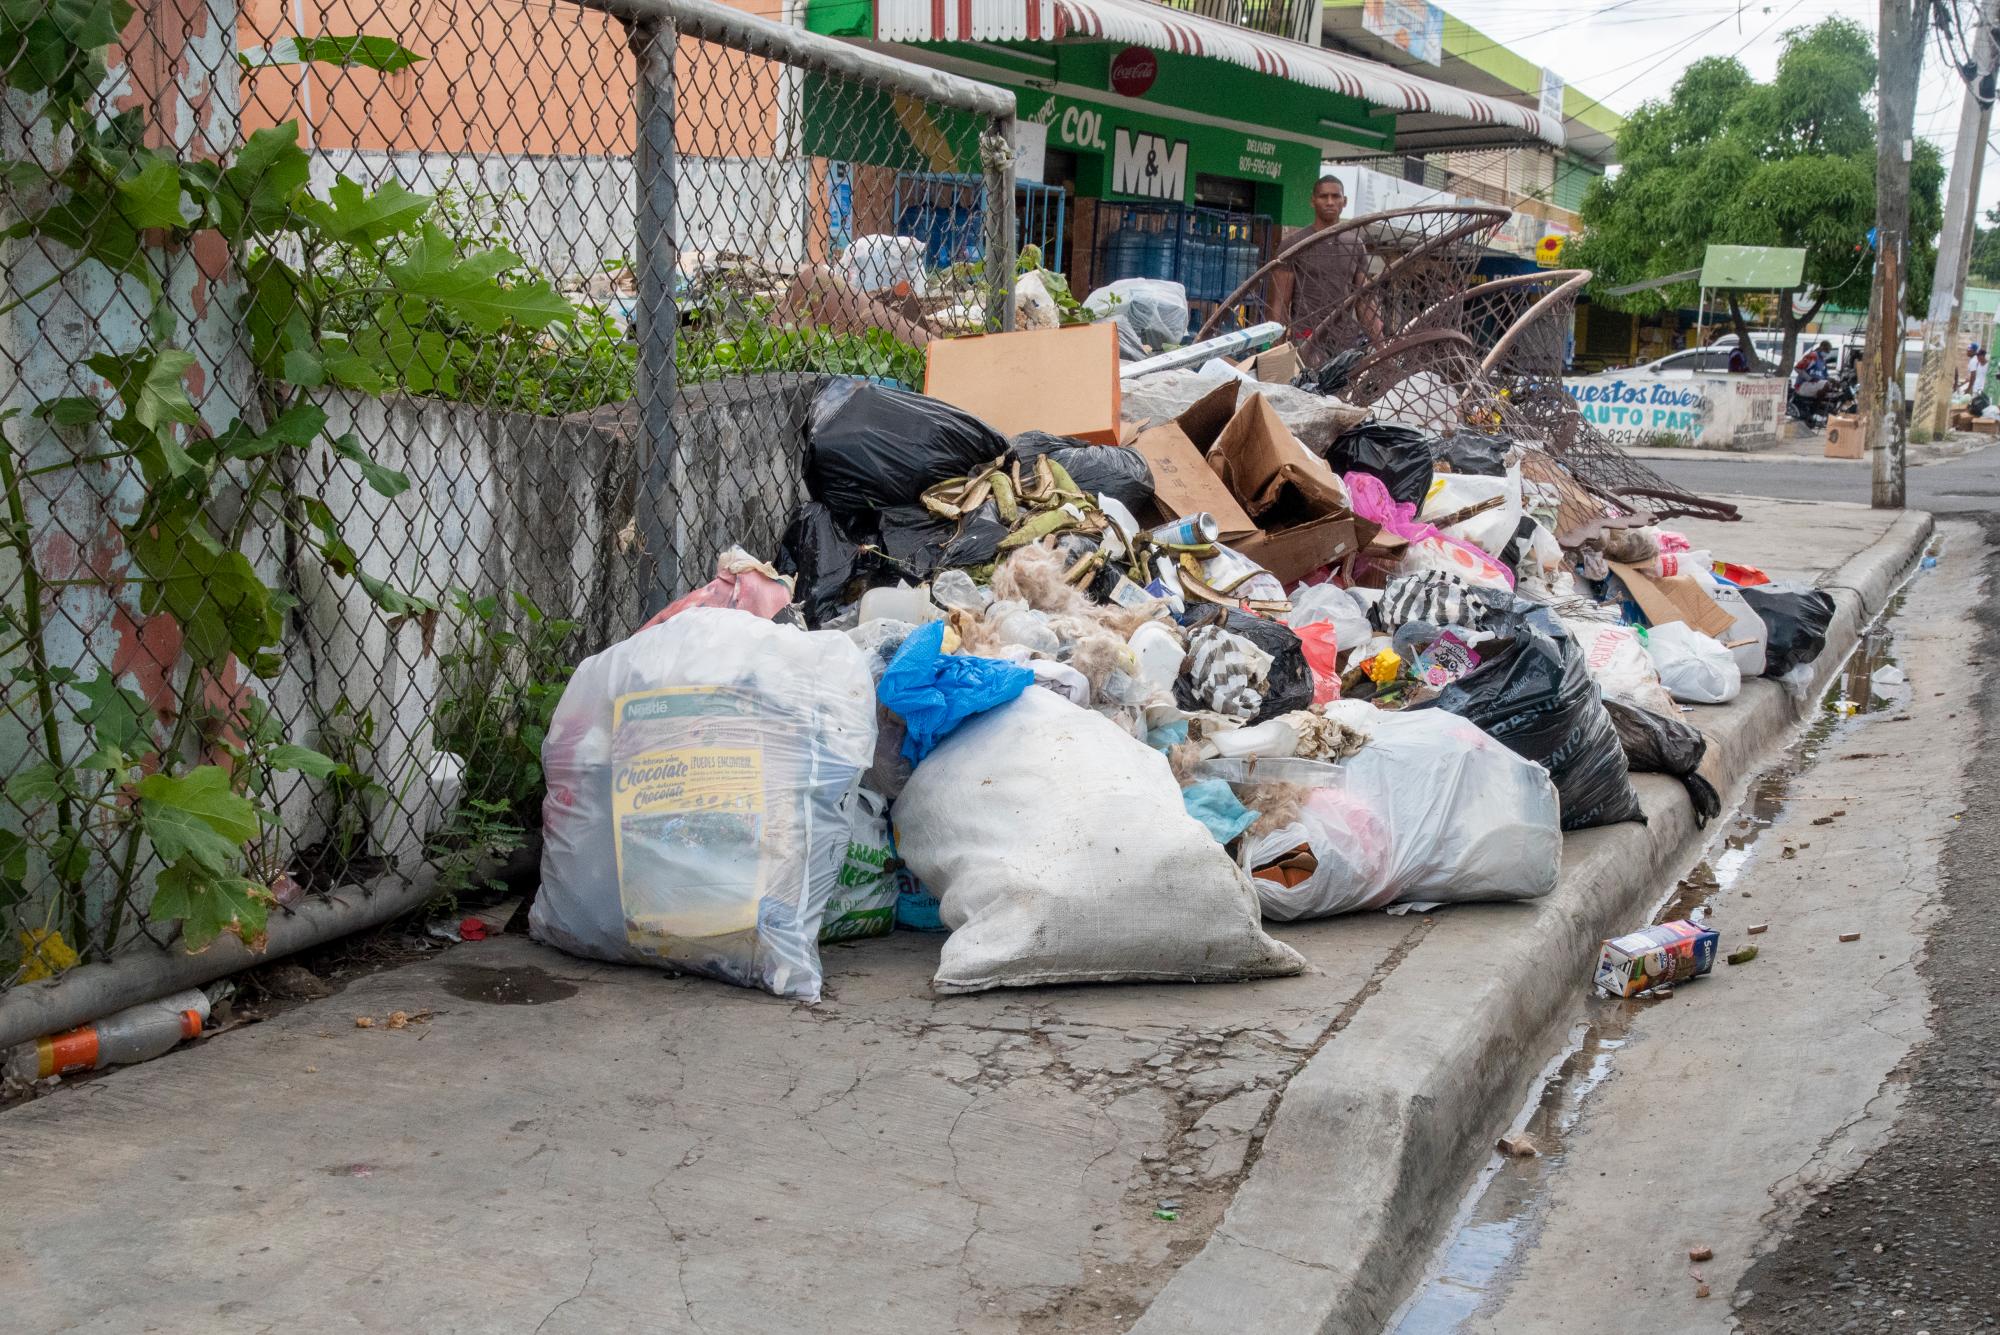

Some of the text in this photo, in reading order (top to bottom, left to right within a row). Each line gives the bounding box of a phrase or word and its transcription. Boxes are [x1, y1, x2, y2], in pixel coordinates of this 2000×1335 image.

[1060, 106, 1107, 150] COL.
[1246, 138, 1276, 156] DELIVERY
[1112, 126, 1189, 202] M&M
[1582, 403, 1643, 426] AUTO
[615, 760, 690, 794] Chocolate
[632, 785, 686, 811] Chocolate
